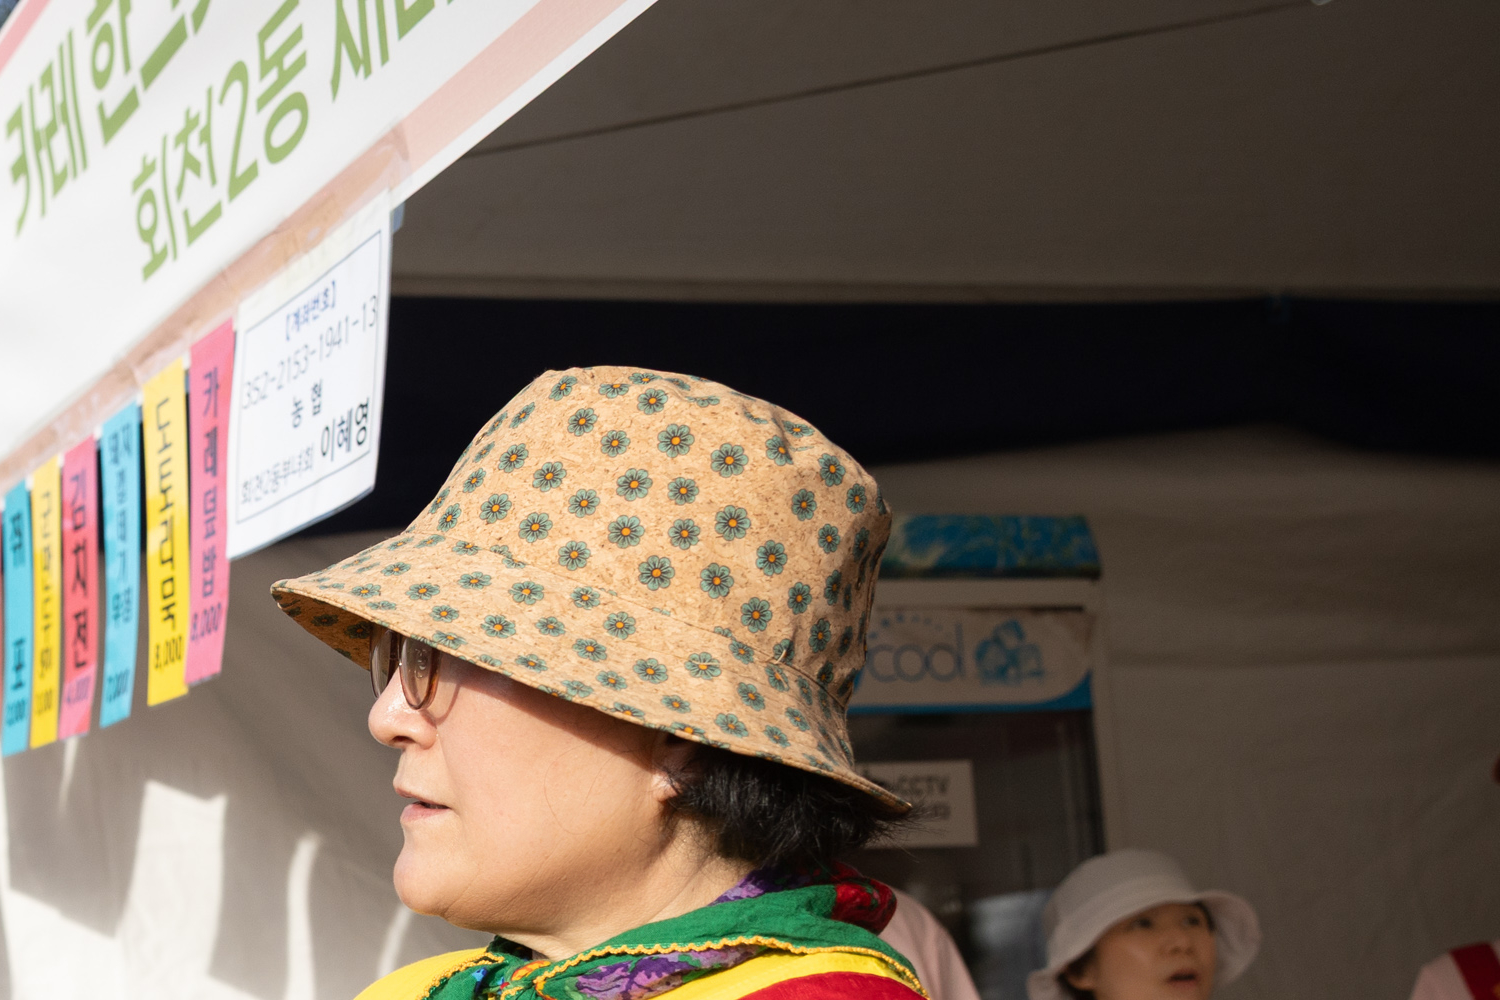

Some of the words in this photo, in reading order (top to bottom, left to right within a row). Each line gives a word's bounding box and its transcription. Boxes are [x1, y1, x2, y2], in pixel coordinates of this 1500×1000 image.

[6, 27, 88, 239] 카레
[131, 0, 309, 282] 회천2동
[321, 397, 370, 461] 이혜영
[70, 468, 88, 669] 김치전
